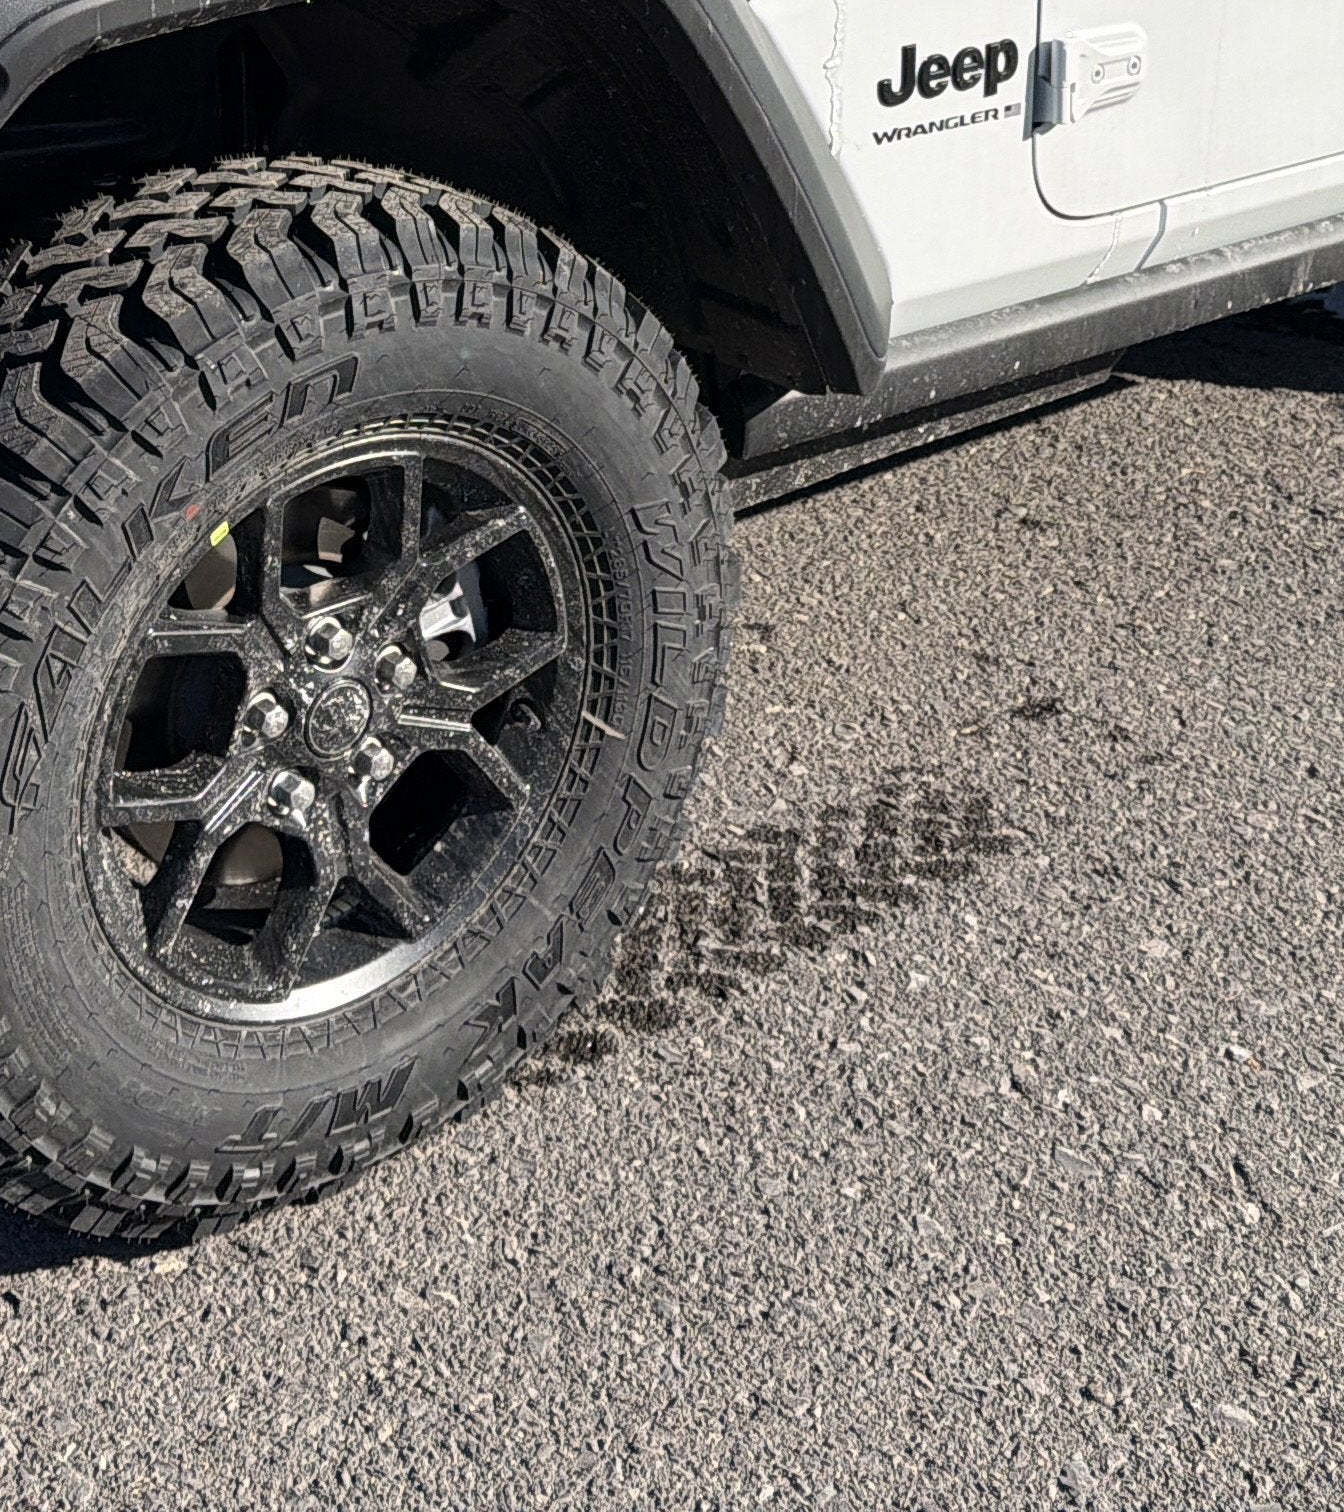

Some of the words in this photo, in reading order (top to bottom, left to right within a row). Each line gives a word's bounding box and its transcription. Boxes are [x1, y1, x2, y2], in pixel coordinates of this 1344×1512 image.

[872, 108, 999, 145] WRANGLER
[877, 38, 1018, 107] Jeep
[0, 355, 359, 834] FALKEN
[460, 496, 689, 1066] WILDPEAK
